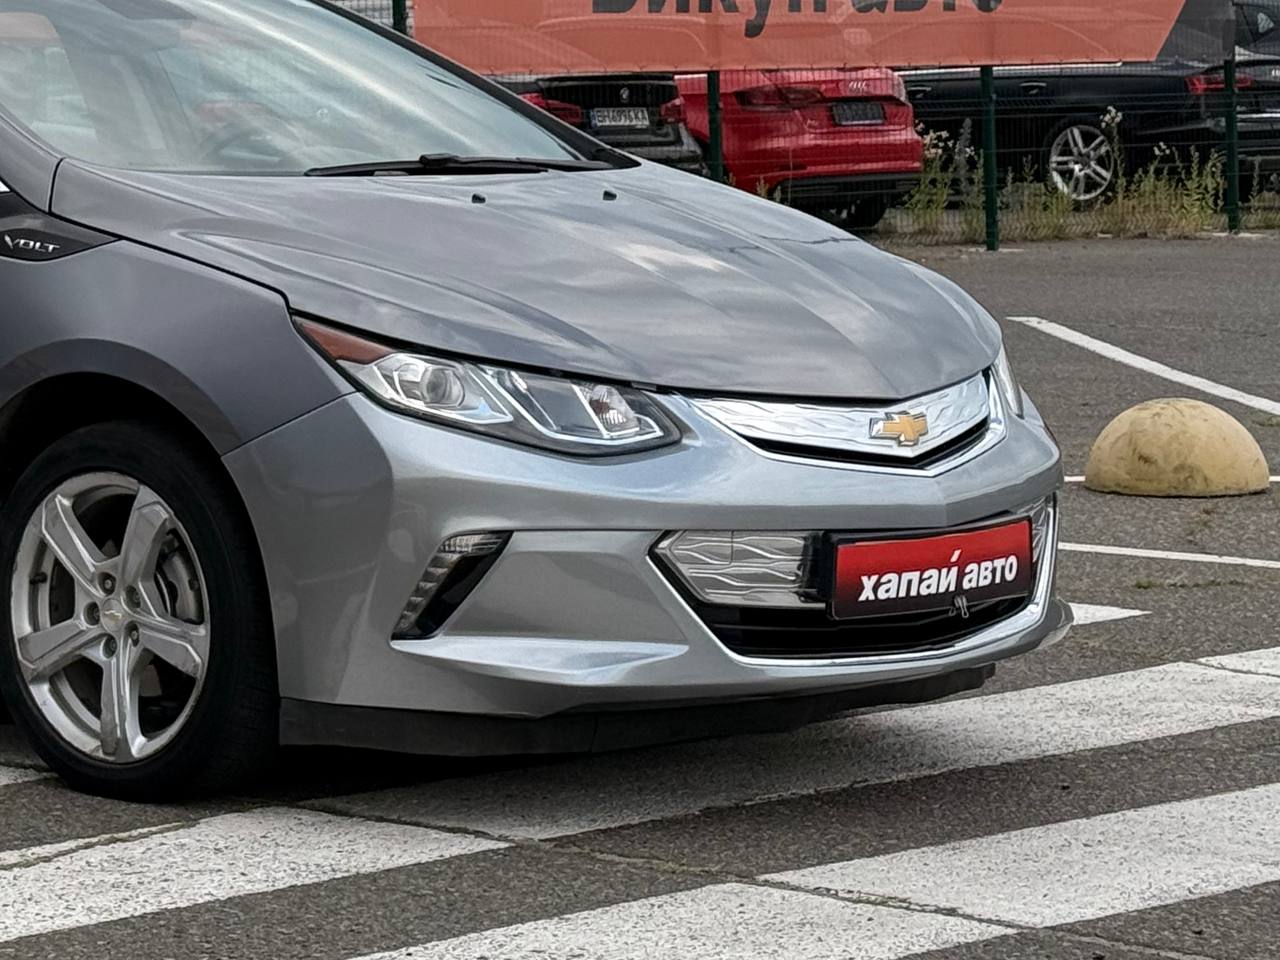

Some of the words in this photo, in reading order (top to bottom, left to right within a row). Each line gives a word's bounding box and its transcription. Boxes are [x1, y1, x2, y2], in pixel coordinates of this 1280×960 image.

[4, 234, 61, 253] VOLT
[858, 549, 962, 602] хапай
[962, 554, 1018, 590] авто
